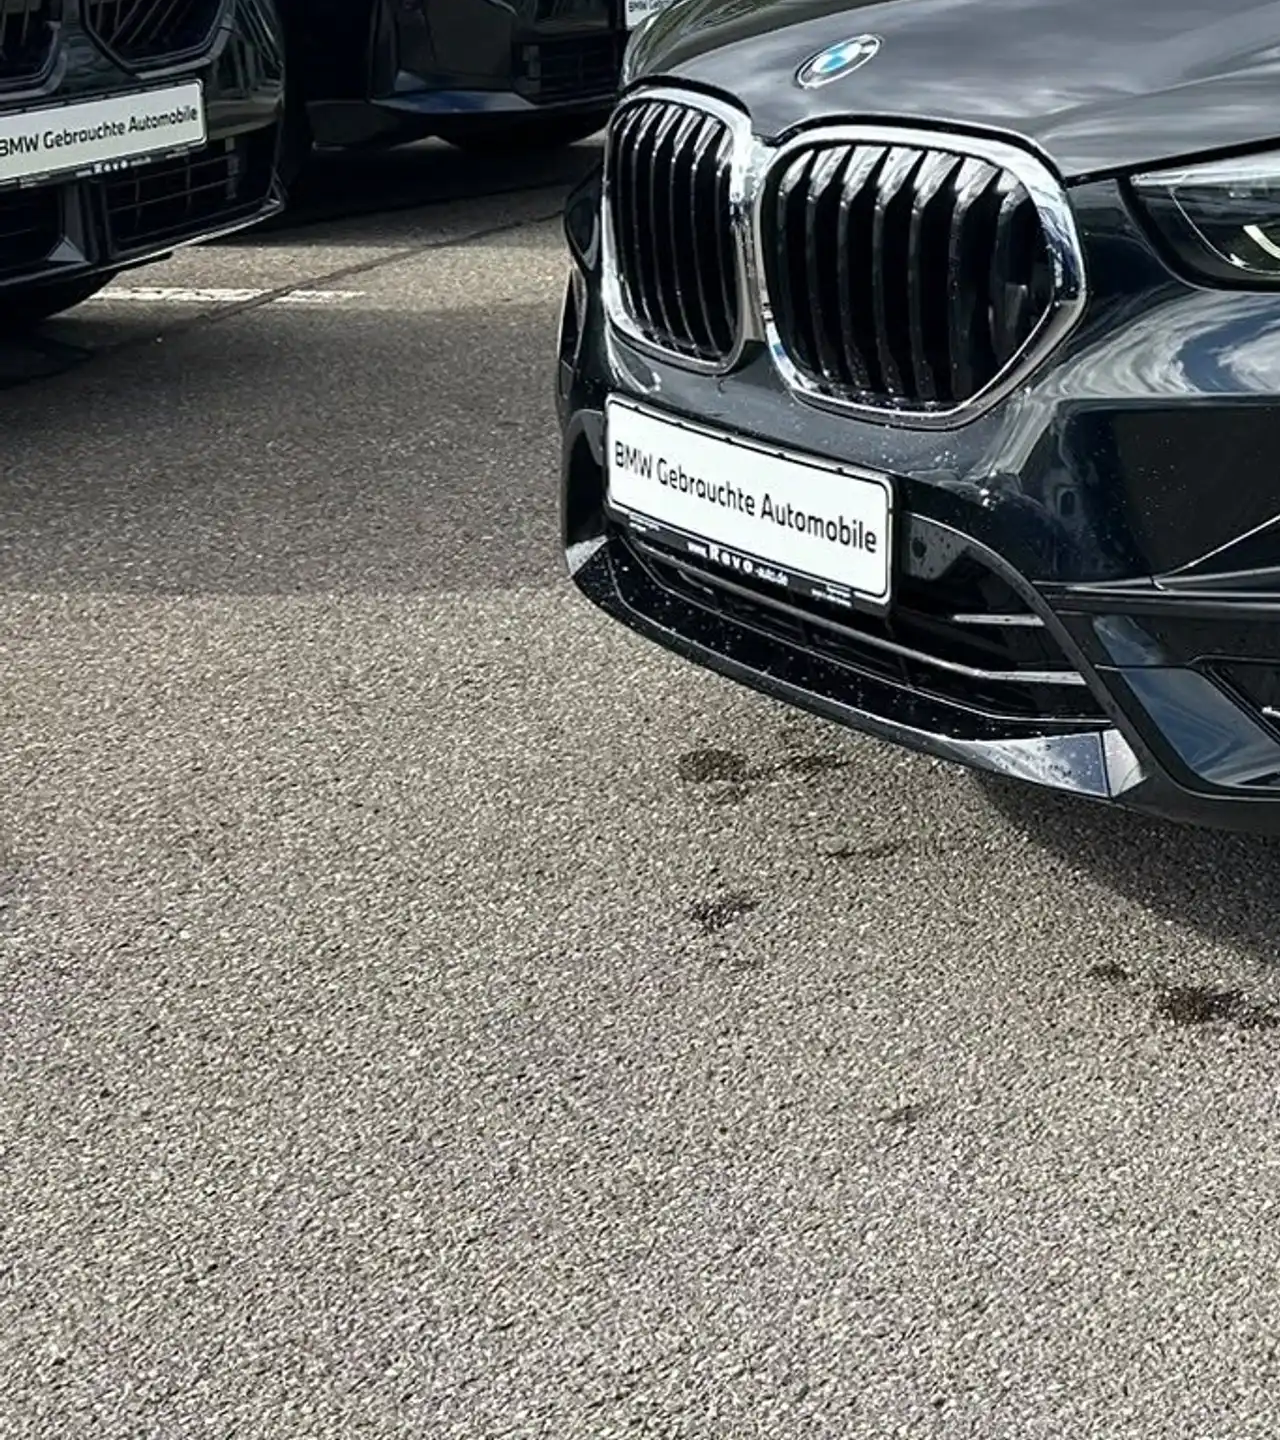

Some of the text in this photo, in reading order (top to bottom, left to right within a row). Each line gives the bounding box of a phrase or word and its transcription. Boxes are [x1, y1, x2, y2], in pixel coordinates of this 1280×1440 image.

[43, 122, 126, 150] Gebrauchte
[127, 105, 198, 134] Automobile
[614, 440, 878, 554] BMW Gebrauchte Automobile
